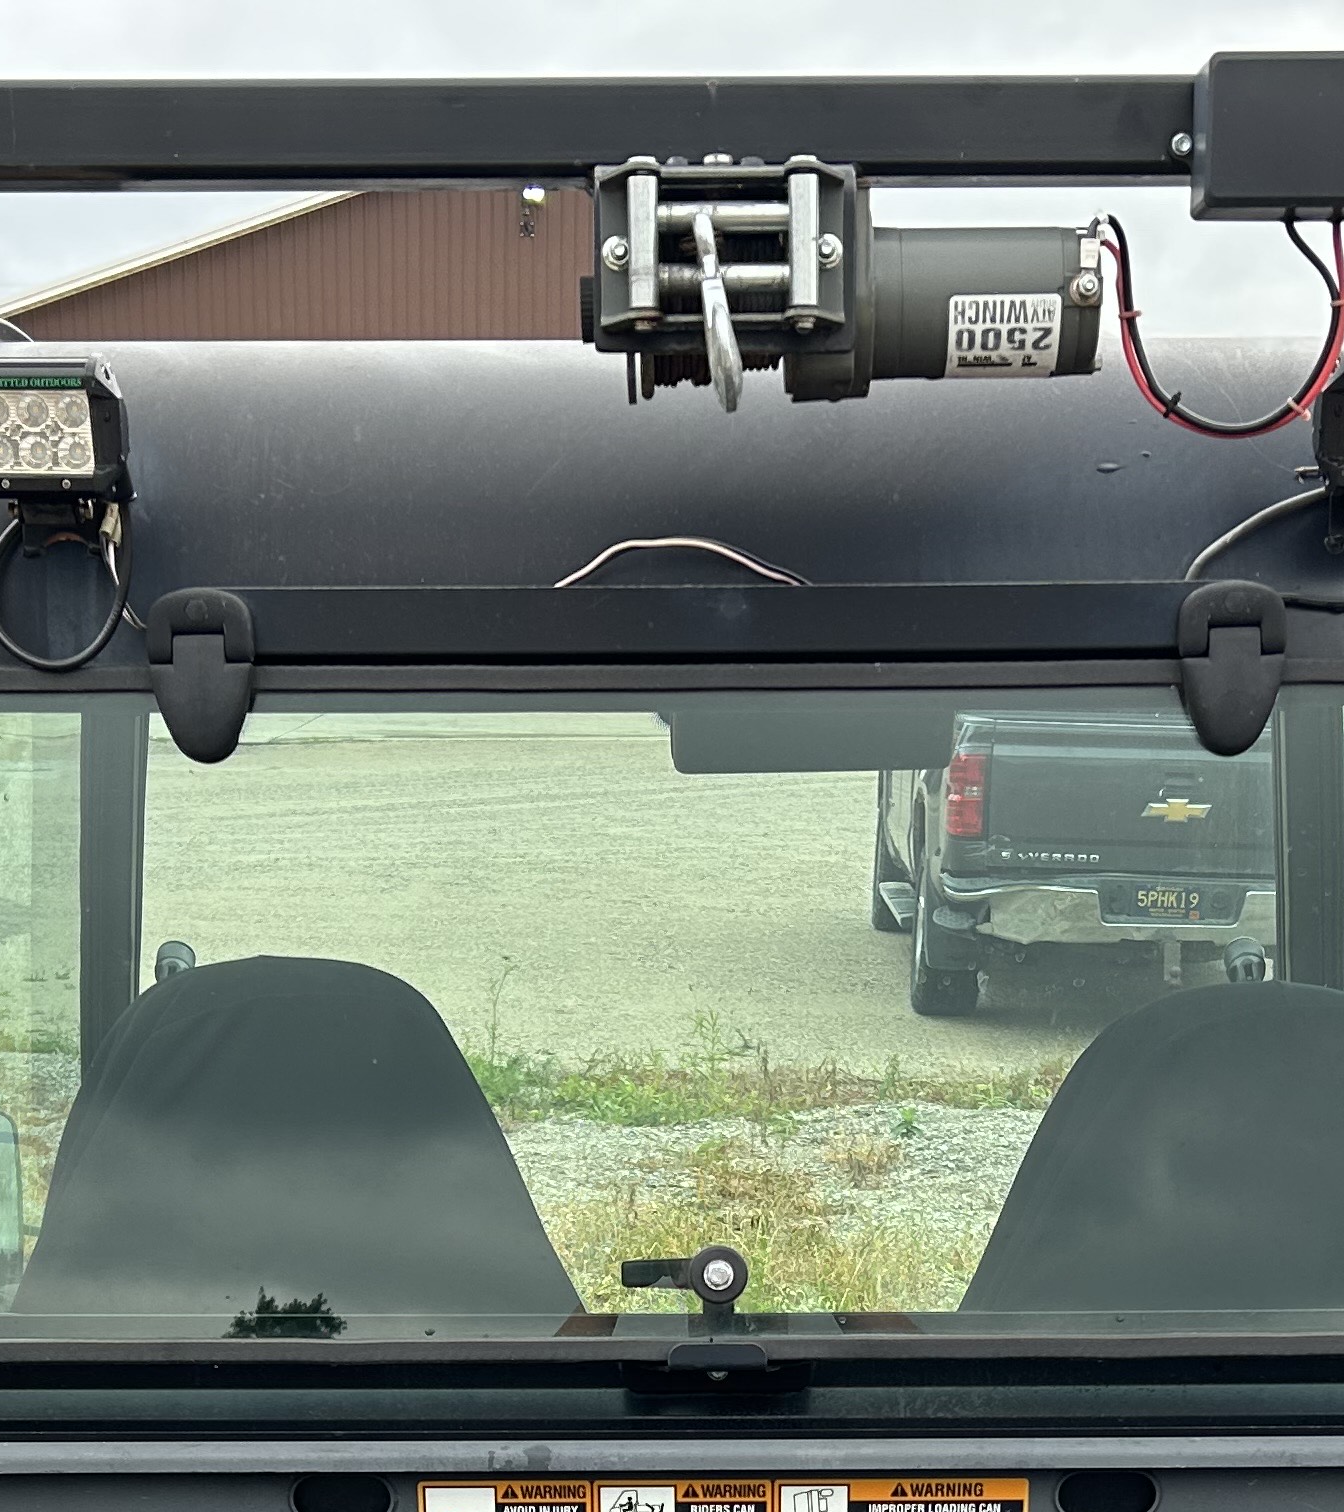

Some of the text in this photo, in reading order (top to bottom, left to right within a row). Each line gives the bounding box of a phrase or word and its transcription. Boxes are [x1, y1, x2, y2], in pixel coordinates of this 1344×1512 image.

[953, 300, 1029, 325] WINCH
[955, 327, 1054, 352] 2500
[29, 377, 82, 387] OUTDOORS
[1000, 851, 1100, 862] SLVERADO
[1137, 890, 1199, 908] 5PHK19
[520, 1485, 586, 1499] WARNING
[701, 1484, 766, 1498] WARNING
[910, 1483, 984, 1497] WARNING
